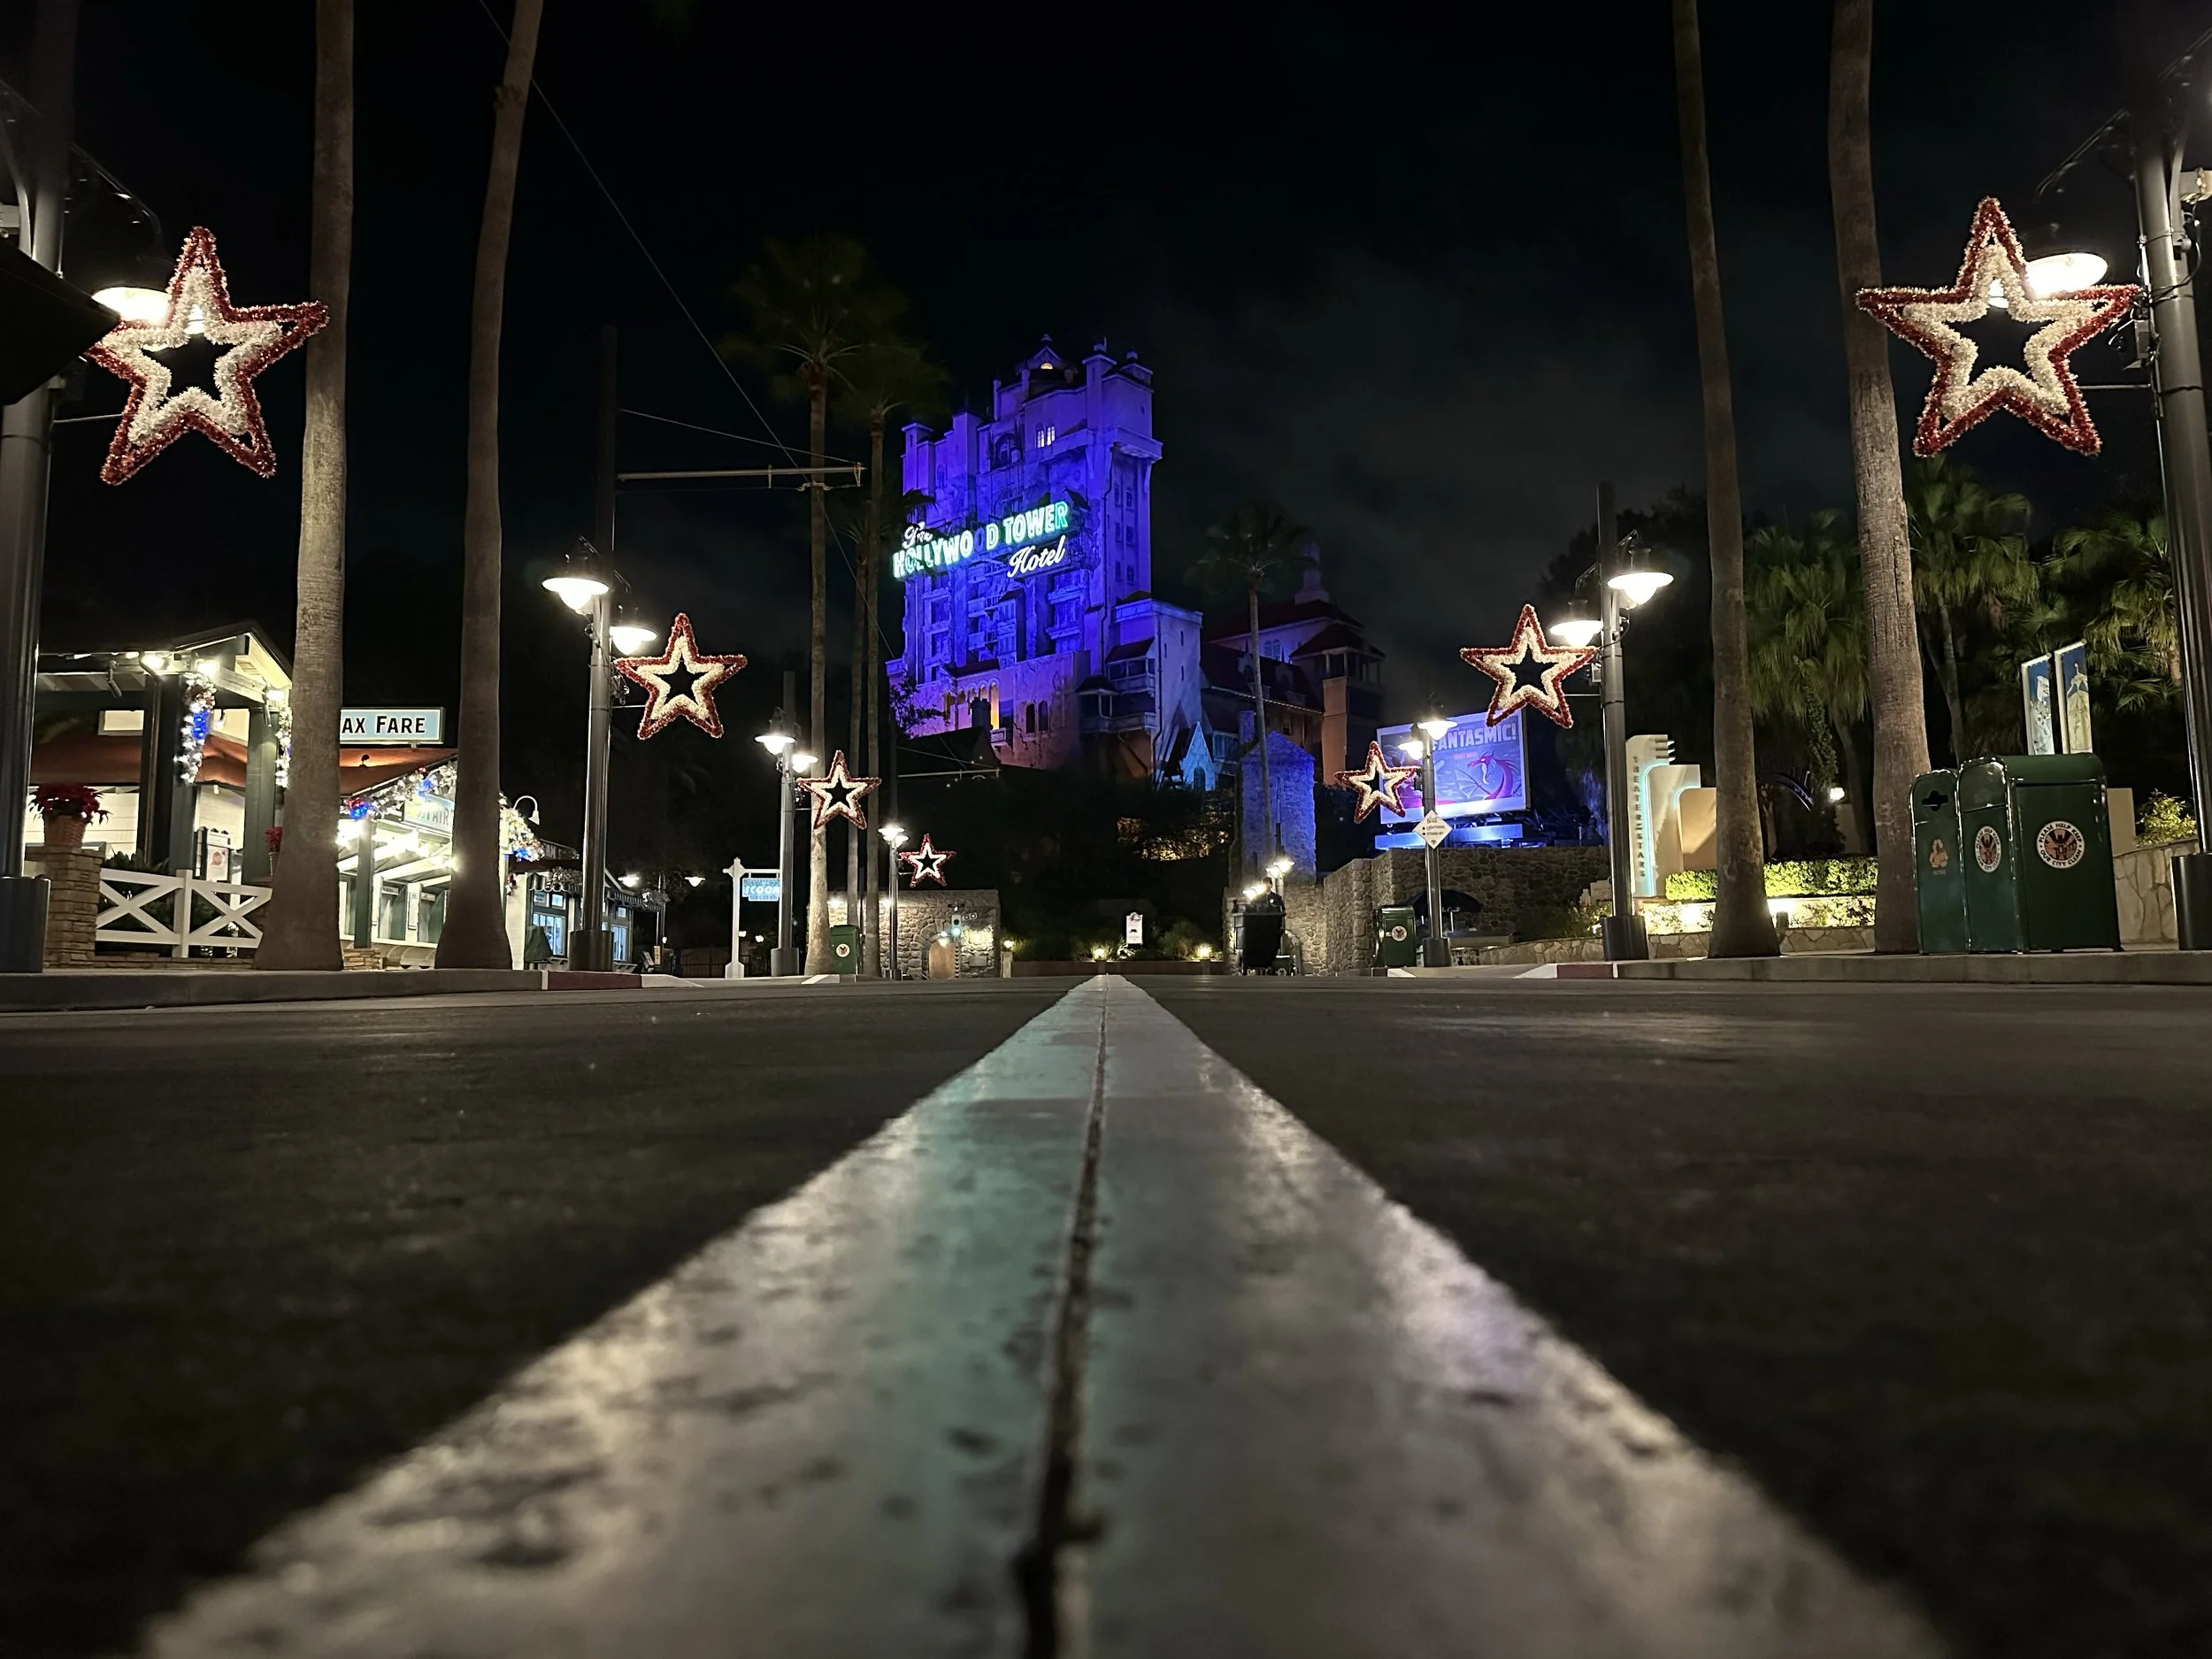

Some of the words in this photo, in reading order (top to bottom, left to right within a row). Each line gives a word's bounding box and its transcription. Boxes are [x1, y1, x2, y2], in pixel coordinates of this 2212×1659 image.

[1002, 501, 1069, 545] TOWER
[1007, 534, 1066, 578] Hotel
[2039, 824, 2054, 843] PLEASE
[2071, 829, 2083, 842] KEEP
[2040, 849, 2052, 862] OUR
[2068, 849, 2082, 865] CLEAN
